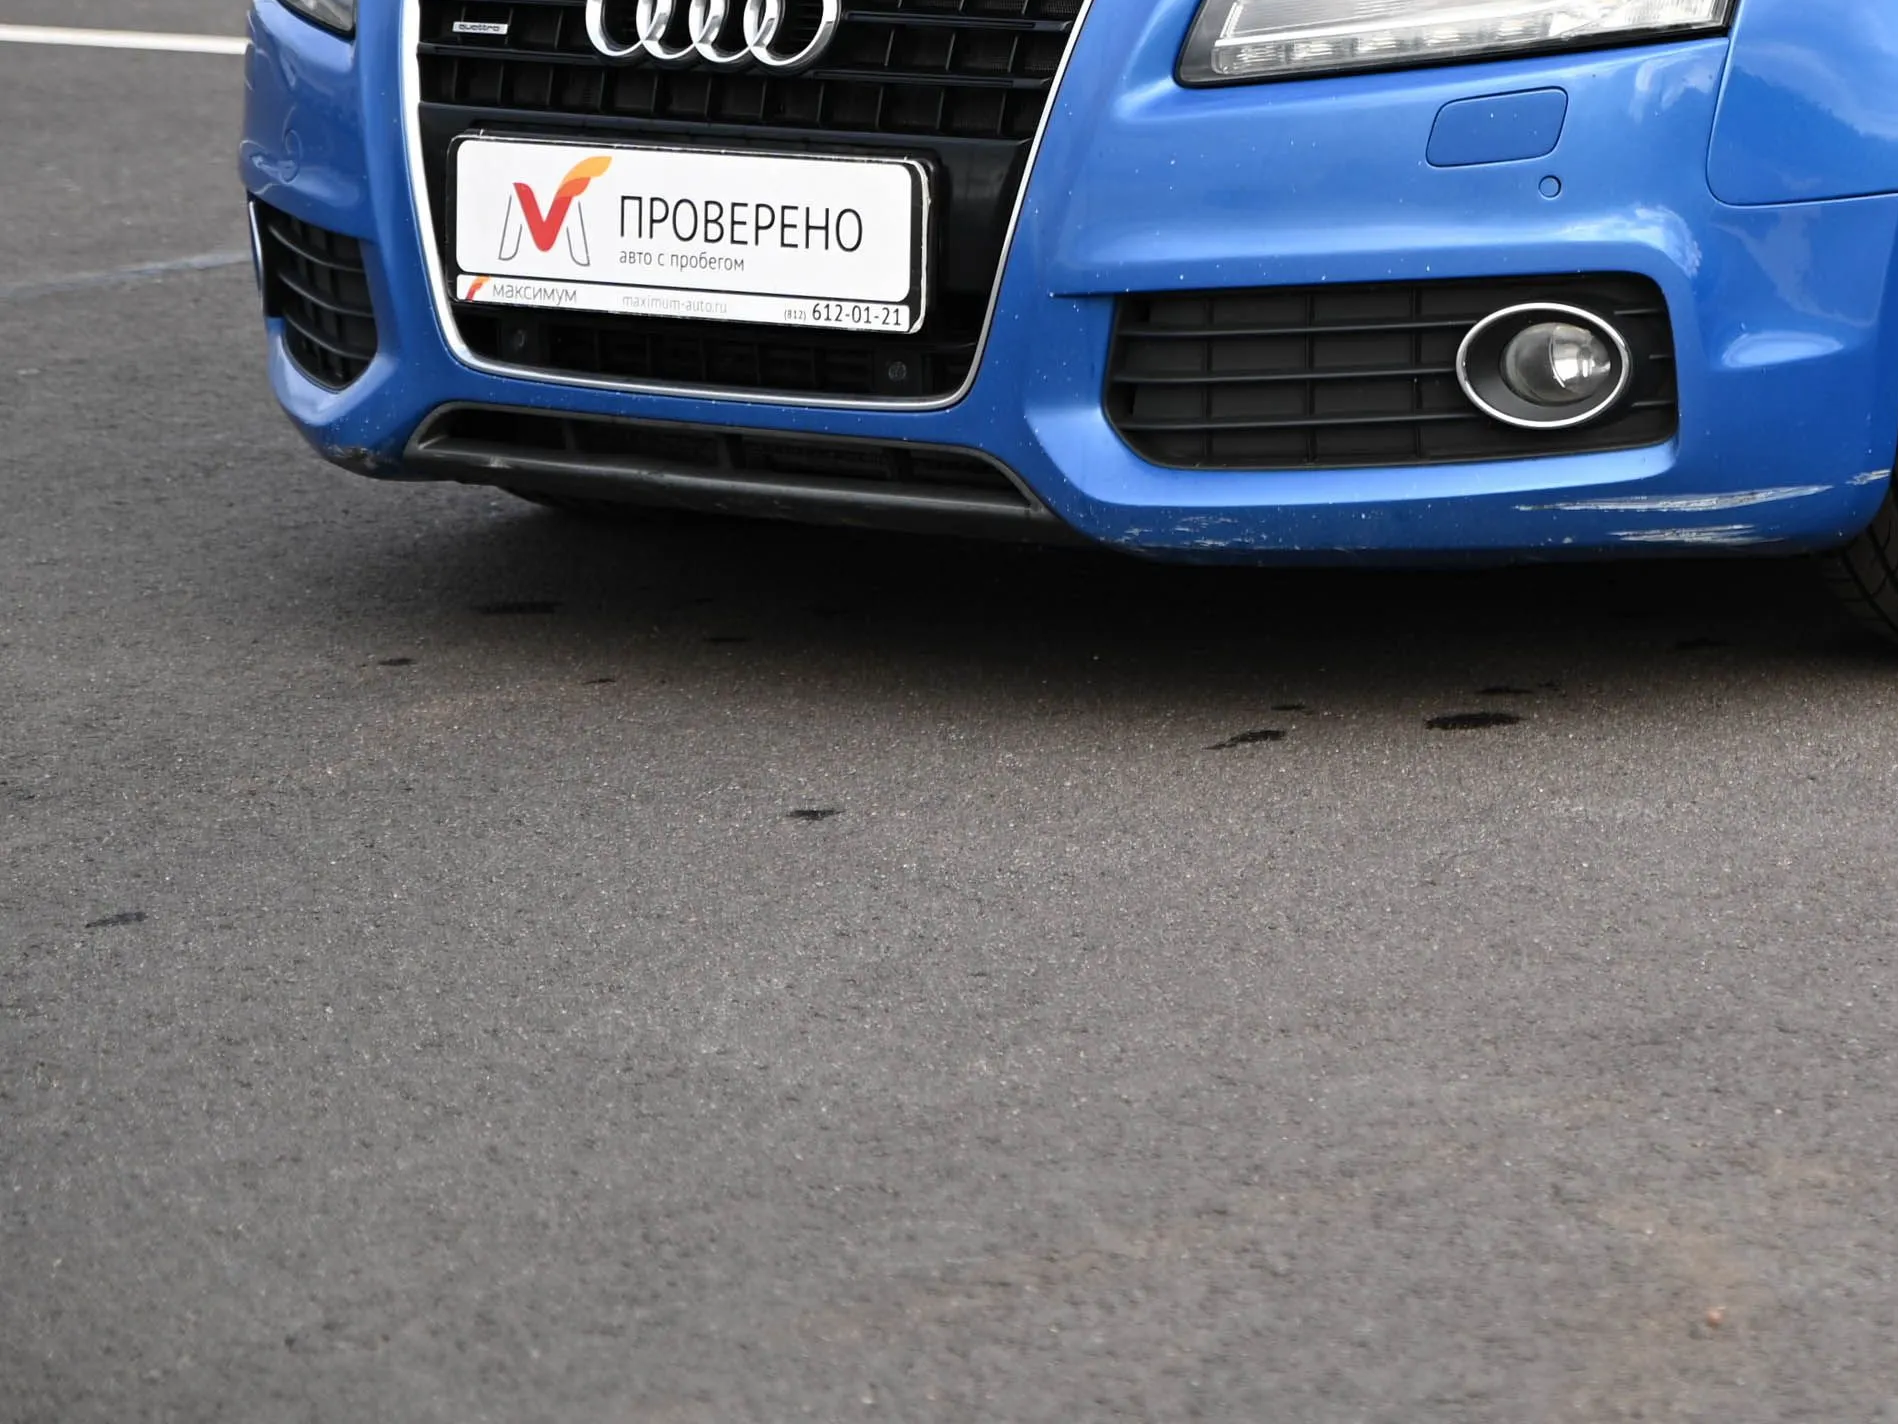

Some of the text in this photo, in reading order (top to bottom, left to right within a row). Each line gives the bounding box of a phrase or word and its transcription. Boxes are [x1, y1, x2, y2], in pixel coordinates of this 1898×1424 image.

[620, 195, 863, 252] ПРОВЕРЕНО
[619, 250, 745, 272] авто с пробегом
[492, 284, 578, 306] максимум
[622, 294, 728, 314] maximum-auto.ru
[784, 303, 902, 326] (812) 612-01-21
